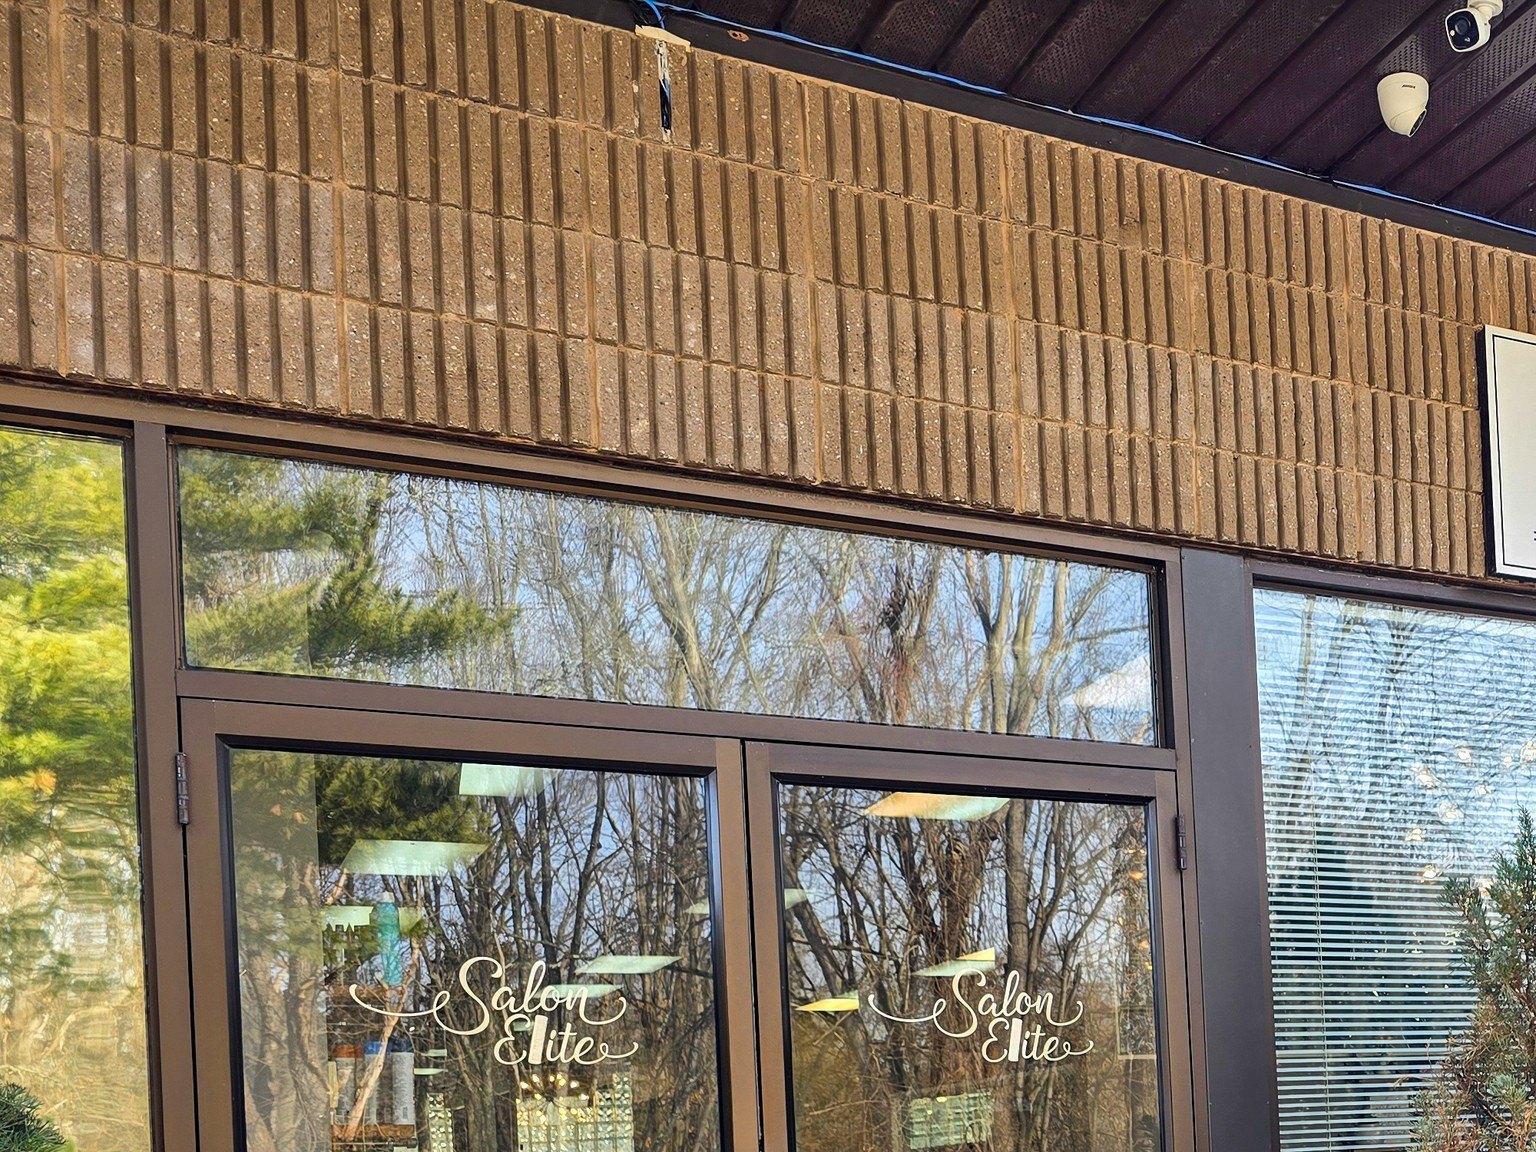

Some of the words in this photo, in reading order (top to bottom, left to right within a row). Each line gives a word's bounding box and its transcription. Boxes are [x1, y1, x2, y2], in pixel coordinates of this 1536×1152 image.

[349, 956, 627, 1036] Salon
[867, 969, 1083, 1038] Salon
[494, 1014, 639, 1065] Elite
[981, 1017, 1094, 1063] Elite
